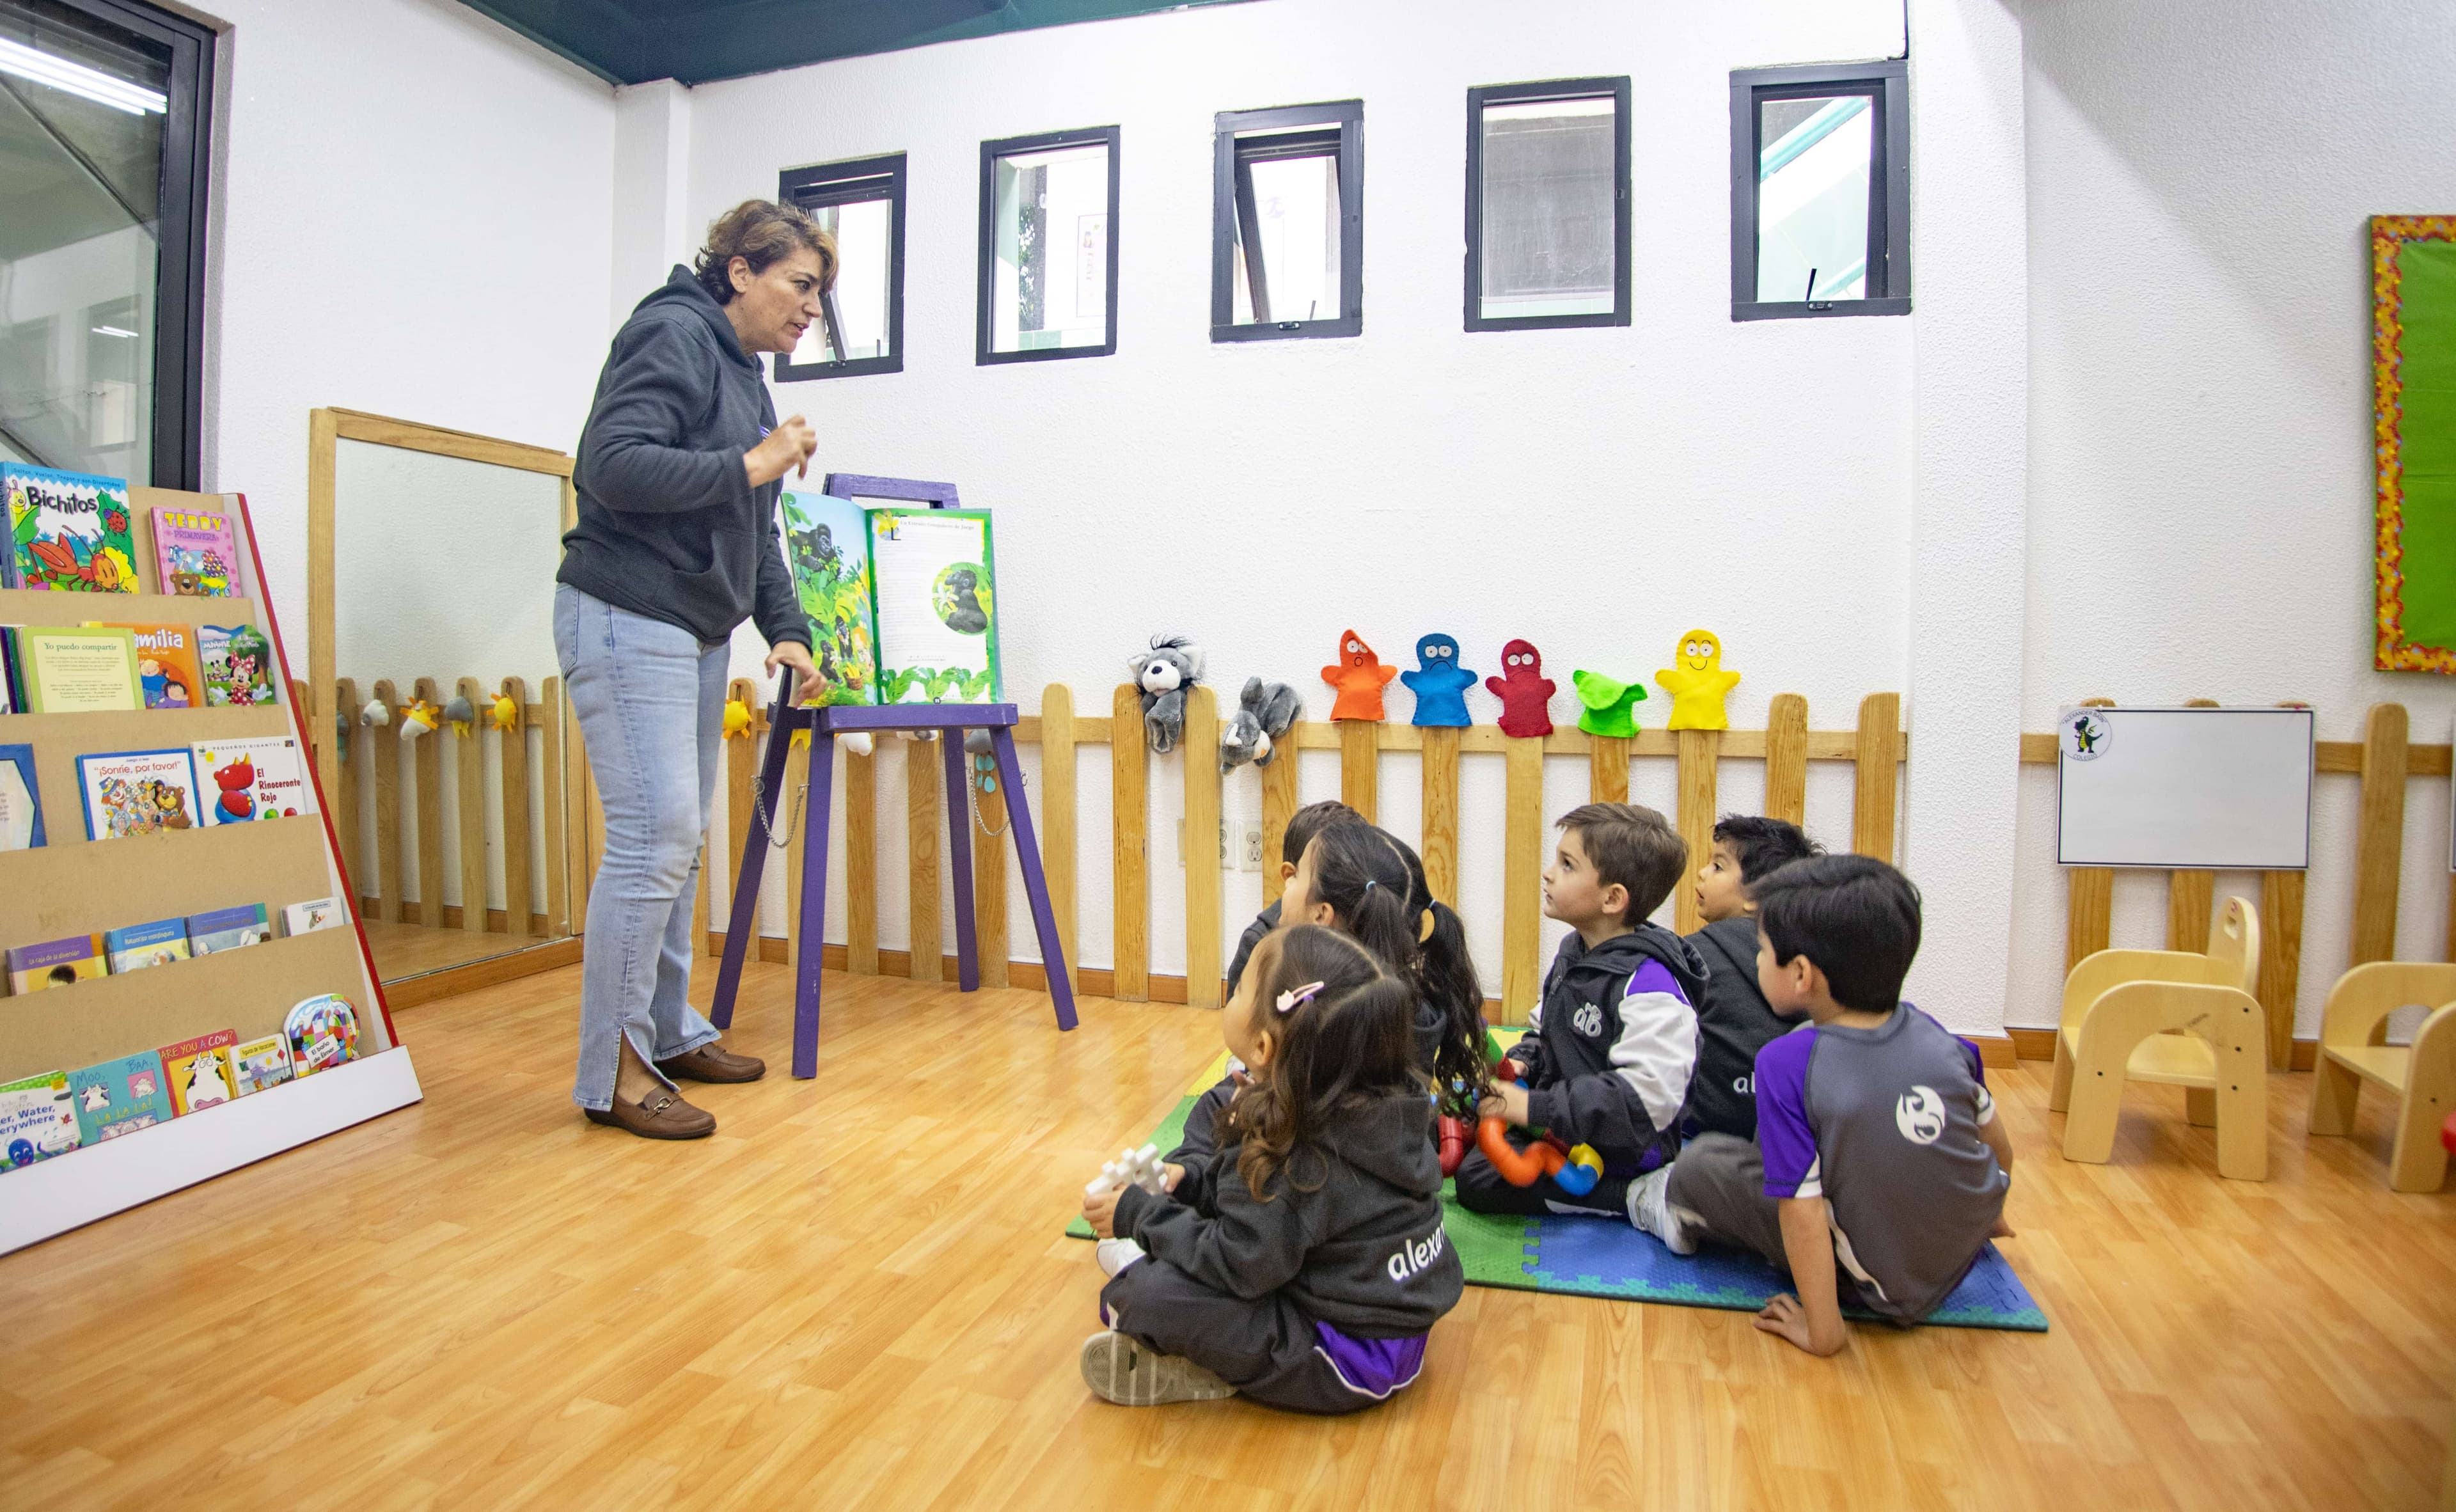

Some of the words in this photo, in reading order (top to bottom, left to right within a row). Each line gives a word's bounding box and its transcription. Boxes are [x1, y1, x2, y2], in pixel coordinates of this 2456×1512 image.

[26, 485, 97, 515] Bichitos
[164, 512, 223, 532] TEDDY
[173, 530, 217, 541] PRIMAVERA
[56, 643, 80, 652] puedo
[82, 643, 117, 652] compartir
[203, 640, 231, 649] MINNIE
[2073, 753, 2098, 761] COLEGIO
[135, 764, 150, 774] por
[257, 768, 264, 778] El
[258, 778, 301, 790] Rinoceronte
[260, 792, 277, 803] Rojo
[161, 1046, 178, 1059] ARE
[181, 1043, 198, 1055] YOU
[200, 1039, 207, 1050] A
[208, 1031, 233, 1046] COW?
[316, 1041, 330, 1051] baño
[320, 1047, 335, 1059] Elmer
[18, 1105, 56, 1119] Water,
[95, 1113, 112, 1125] LA
[116, 1106, 130, 1118] LA
[0, 1115, 55, 1135] erywhere
